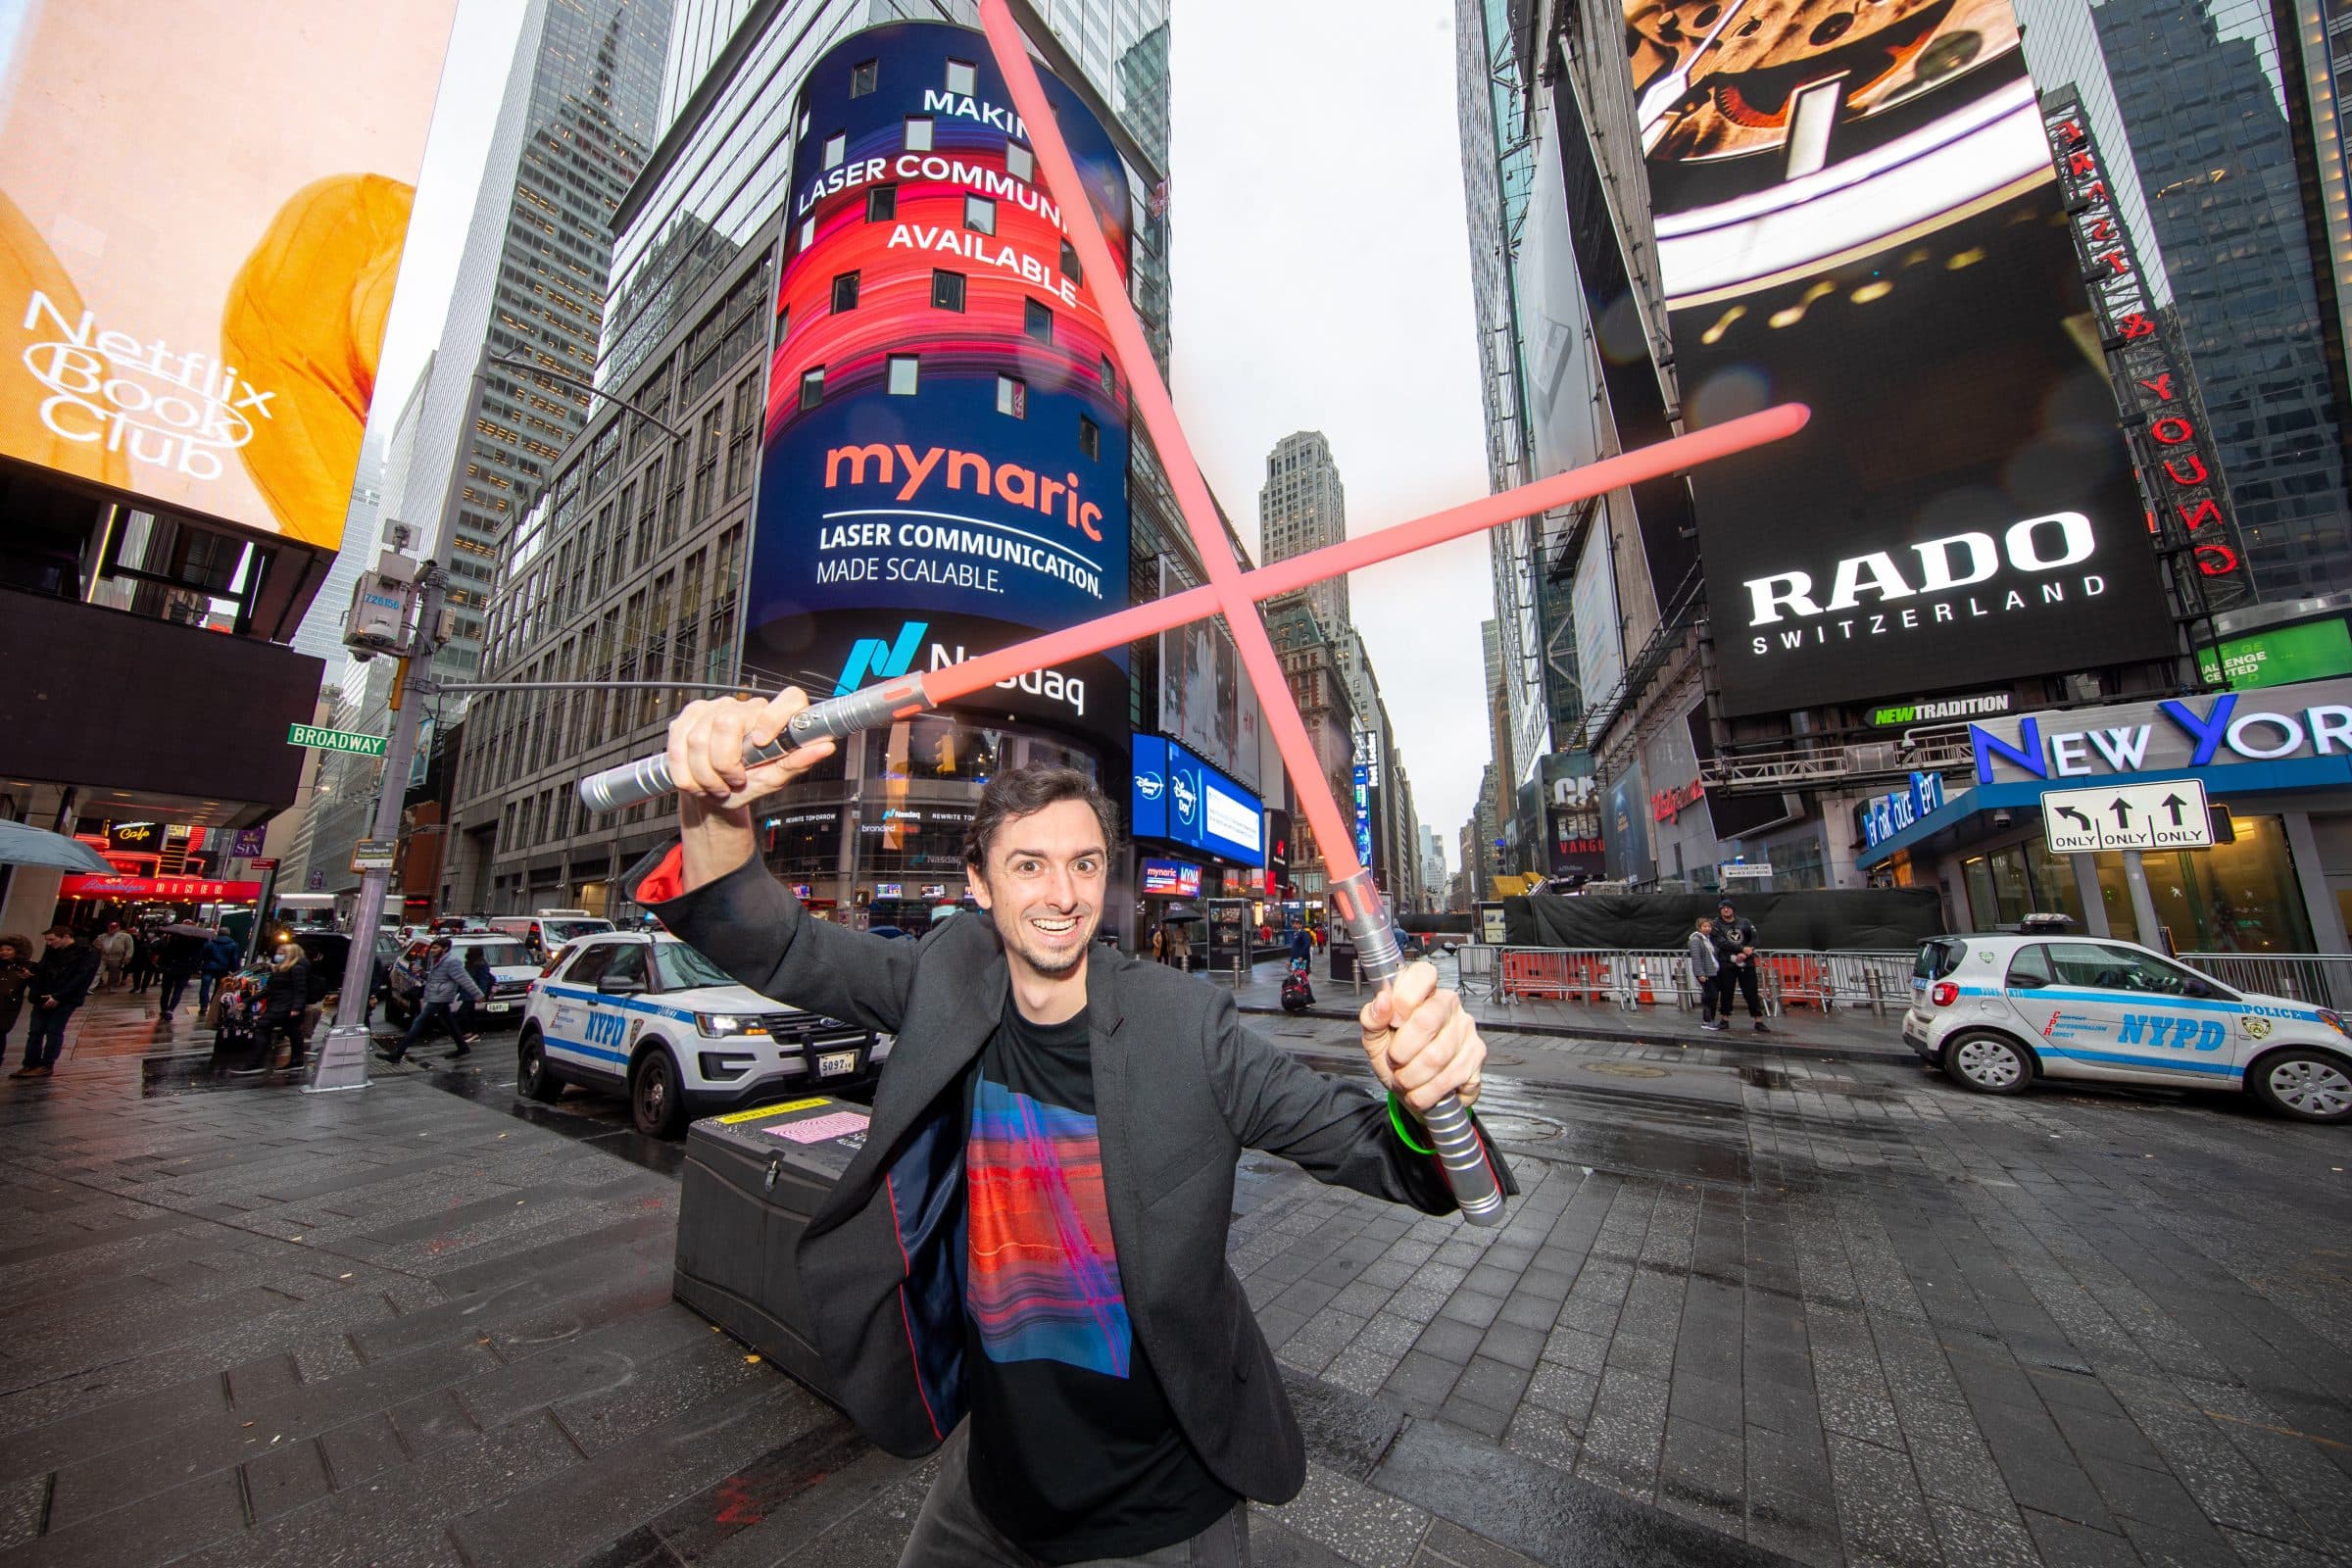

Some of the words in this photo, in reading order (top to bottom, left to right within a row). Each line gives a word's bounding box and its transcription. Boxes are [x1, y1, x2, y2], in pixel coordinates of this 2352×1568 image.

[798, 158, 886, 216] LASER
[887, 224, 1077, 310] AVAILABLE
[23, 290, 276, 419] Netflix
[47, 346, 242, 444] Book
[40, 397, 223, 480] Club
[825, 443, 1103, 542] mynaric
[816, 558, 878, 584] MADE
[886, 558, 1004, 594] SCALABLE.
[819, 523, 891, 550] LASER
[899, 524, 1103, 600] COMMUNICATION.
[1742, 511, 2096, 627] RADO
[365, 593, 400, 611] 726156
[1752, 574, 2106, 655] SWITZERLAND
[930, 643, 1085, 716] Ndaq
[293, 726, 382, 755] BROADWAY
[1968, 716, 2152, 784] NEW
[120, 828, 150, 841] Cafe
[861, 824, 896, 833] branded
[895, 810, 921, 820] Nasdaq
[932, 812, 960, 821] REWRITE
[2055, 835, 2095, 848] ONLY
[2103, 831, 2148, 846] ONLY
[2157, 829, 2203, 844] ONLY
[156, 884, 222, 895] DINER
[1147, 867, 1177, 878] mynaric
[585, 1010, 626, 1047] NYPD
[2241, 1004, 2302, 1019] POLICE
[2117, 1013, 2227, 1052] NYPD
[822, 1059, 845, 1071] 5097
